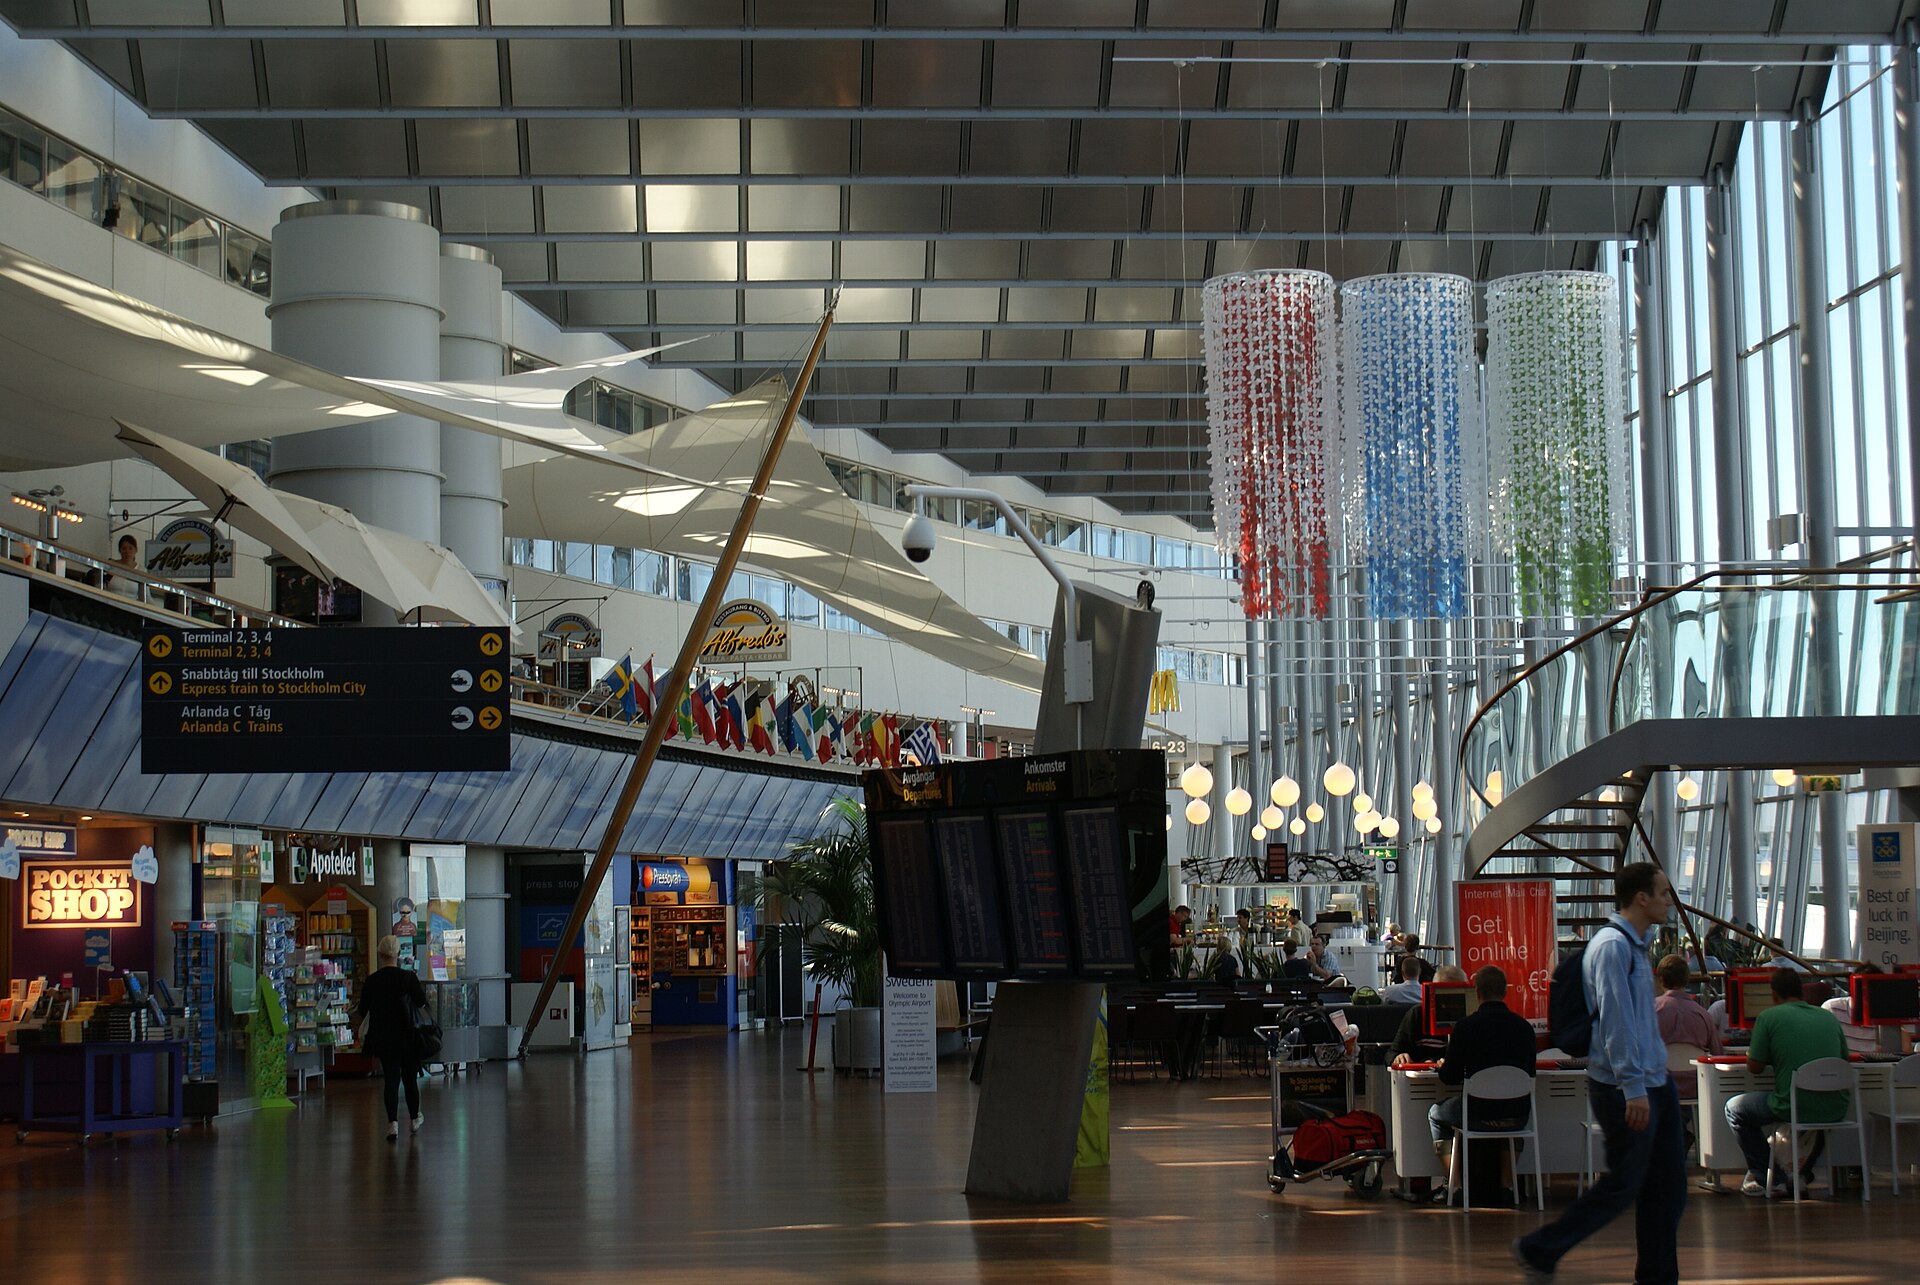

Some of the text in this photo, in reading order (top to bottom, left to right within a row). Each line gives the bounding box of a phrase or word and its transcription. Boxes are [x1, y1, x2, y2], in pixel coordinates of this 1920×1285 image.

[753, 607, 771, 624] BISTRO
[182, 631, 273, 644] Terminal 2, 3, 4
[701, 625, 787, 656] Alfredo's
[182, 646, 272, 659] Terminal 2, 3, 4
[182, 667, 325, 682] Snabbtåg till Stockholm
[182, 681, 367, 697] Express train to Stockholm City
[182, 705, 272, 720] Arlanda C Tåg
[181, 720, 284, 733] Arlanda C Trains
[1024, 760, 1067, 775] Ankomster
[903, 770, 936, 787] Avgångar
[1026, 776, 1058, 793] Arrivals
[903, 787, 943, 804] Departures
[310, 847, 357, 883] Apoteket
[32, 868, 132, 890] POCKET
[526, 879, 580, 891] press stop
[1464, 886, 1547, 899] Internet Mail Chat
[1867, 888, 1911, 903] Best of
[31, 888, 134, 921] SHOP
[1868, 907, 1909, 922] luck in
[1467, 914, 1503, 935] Get
[1867, 927, 1911, 944] Beijing.
[1468, 943, 1528, 962] online
[1881, 950, 1898, 965] Go
[892, 991, 927, 1000] Welcome to
[888, 999, 931, 1008] Olympic Airport
